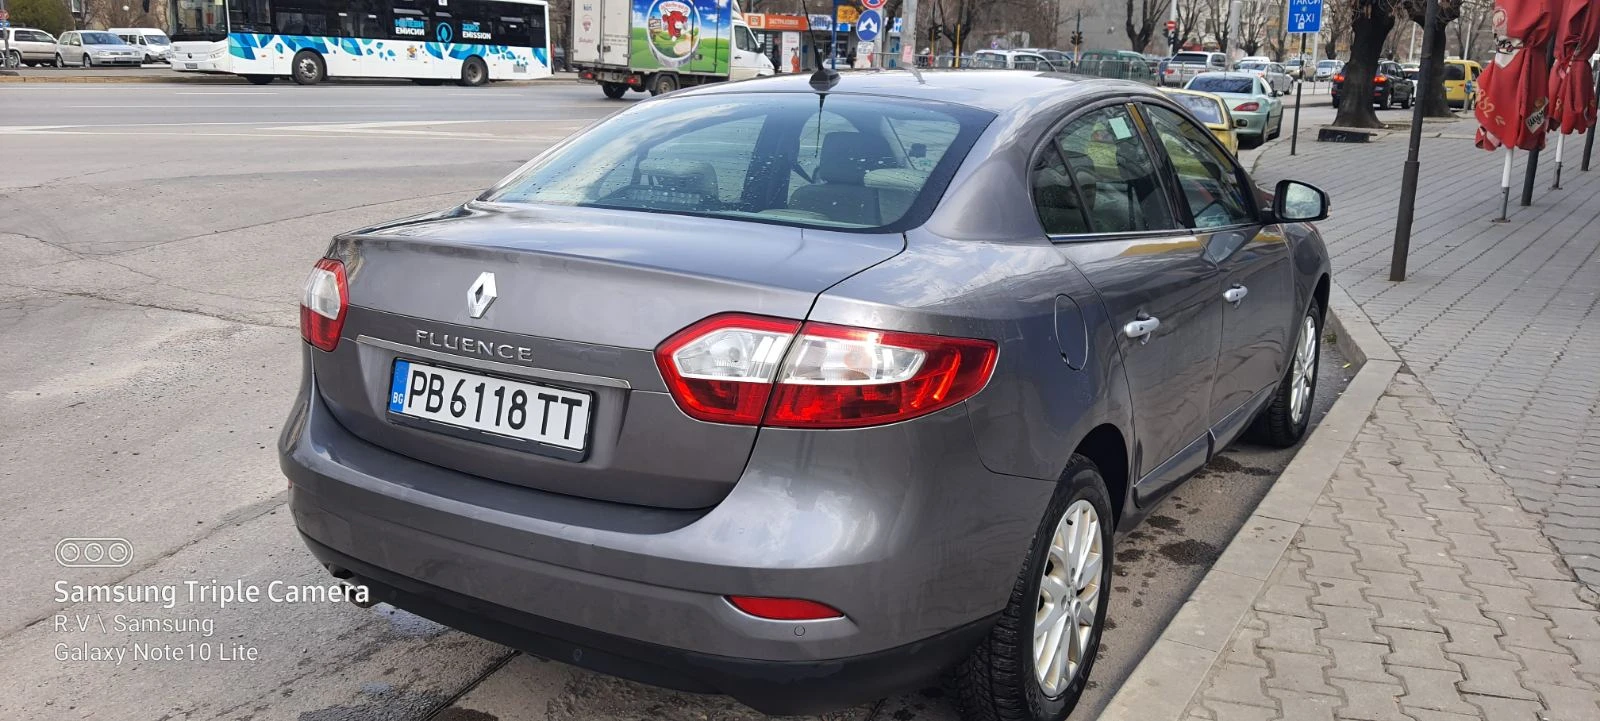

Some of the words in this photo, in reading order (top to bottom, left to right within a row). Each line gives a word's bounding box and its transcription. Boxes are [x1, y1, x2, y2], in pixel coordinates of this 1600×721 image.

[1294, 13, 1315, 23] TAXI
[462, 31, 492, 40] EMISSION
[416, 329, 533, 362] FLUENCE
[393, 392, 404, 404] BG
